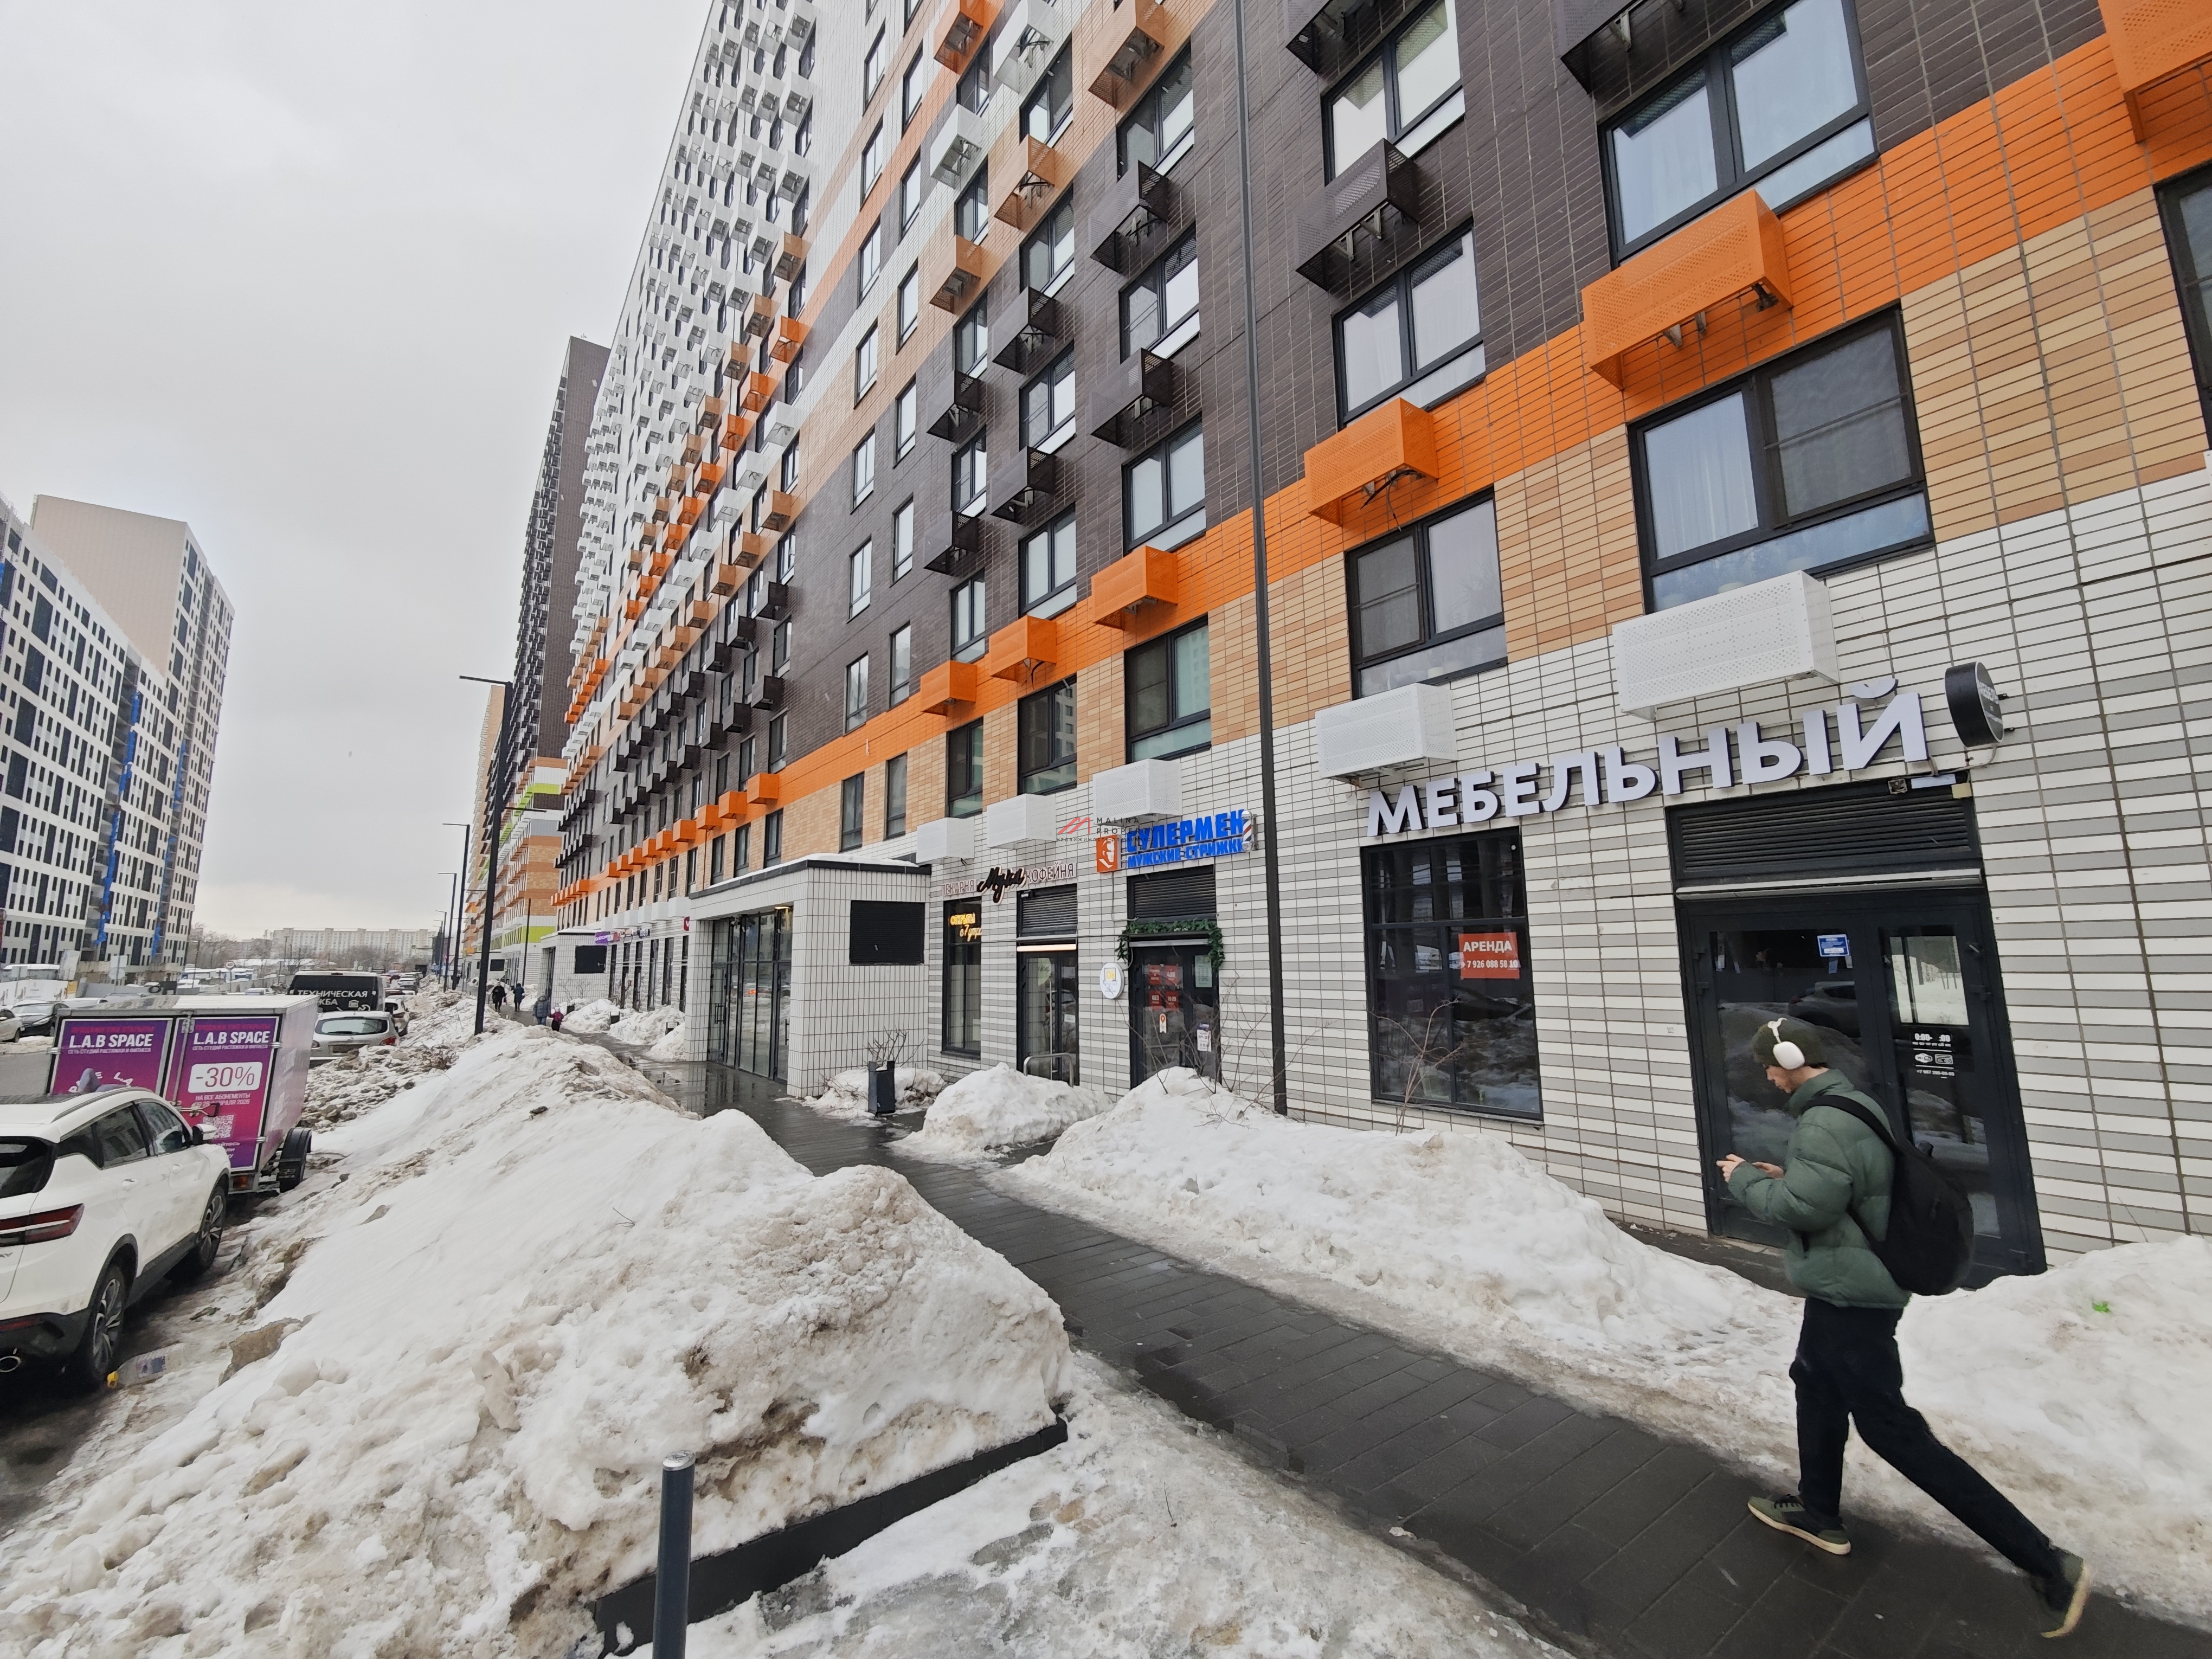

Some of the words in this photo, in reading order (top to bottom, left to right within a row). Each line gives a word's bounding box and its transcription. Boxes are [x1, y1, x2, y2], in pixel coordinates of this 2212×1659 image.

[1366, 678, 1928, 837] МЕБЕЛЬНЫЙ
[1127, 809, 1245, 853] СУПЕРМЕН
[1128, 847, 1181, 869] МУЖСКИЕ
[1185, 838, 1244, 859] СТРИЖКИ
[941, 879, 976, 896] ПЕКАРНЯ
[1026, 861, 1076, 884] КОФЕЙНЯ
[1463, 940, 1513, 953] АРЕНДА
[1472, 960, 1485, 968] 926
[1486, 960, 1499, 968] 088
[1500, 960, 1508, 968] 58
[1509, 960, 1519, 968] 10
[69, 1034, 106, 1048] L.A.B
[108, 1034, 154, 1047] SPACE
[194, 1032, 227, 1045] L.A.B
[229, 1031, 271, 1044] SPACE
[196, 1066, 255, 1088] -30%
